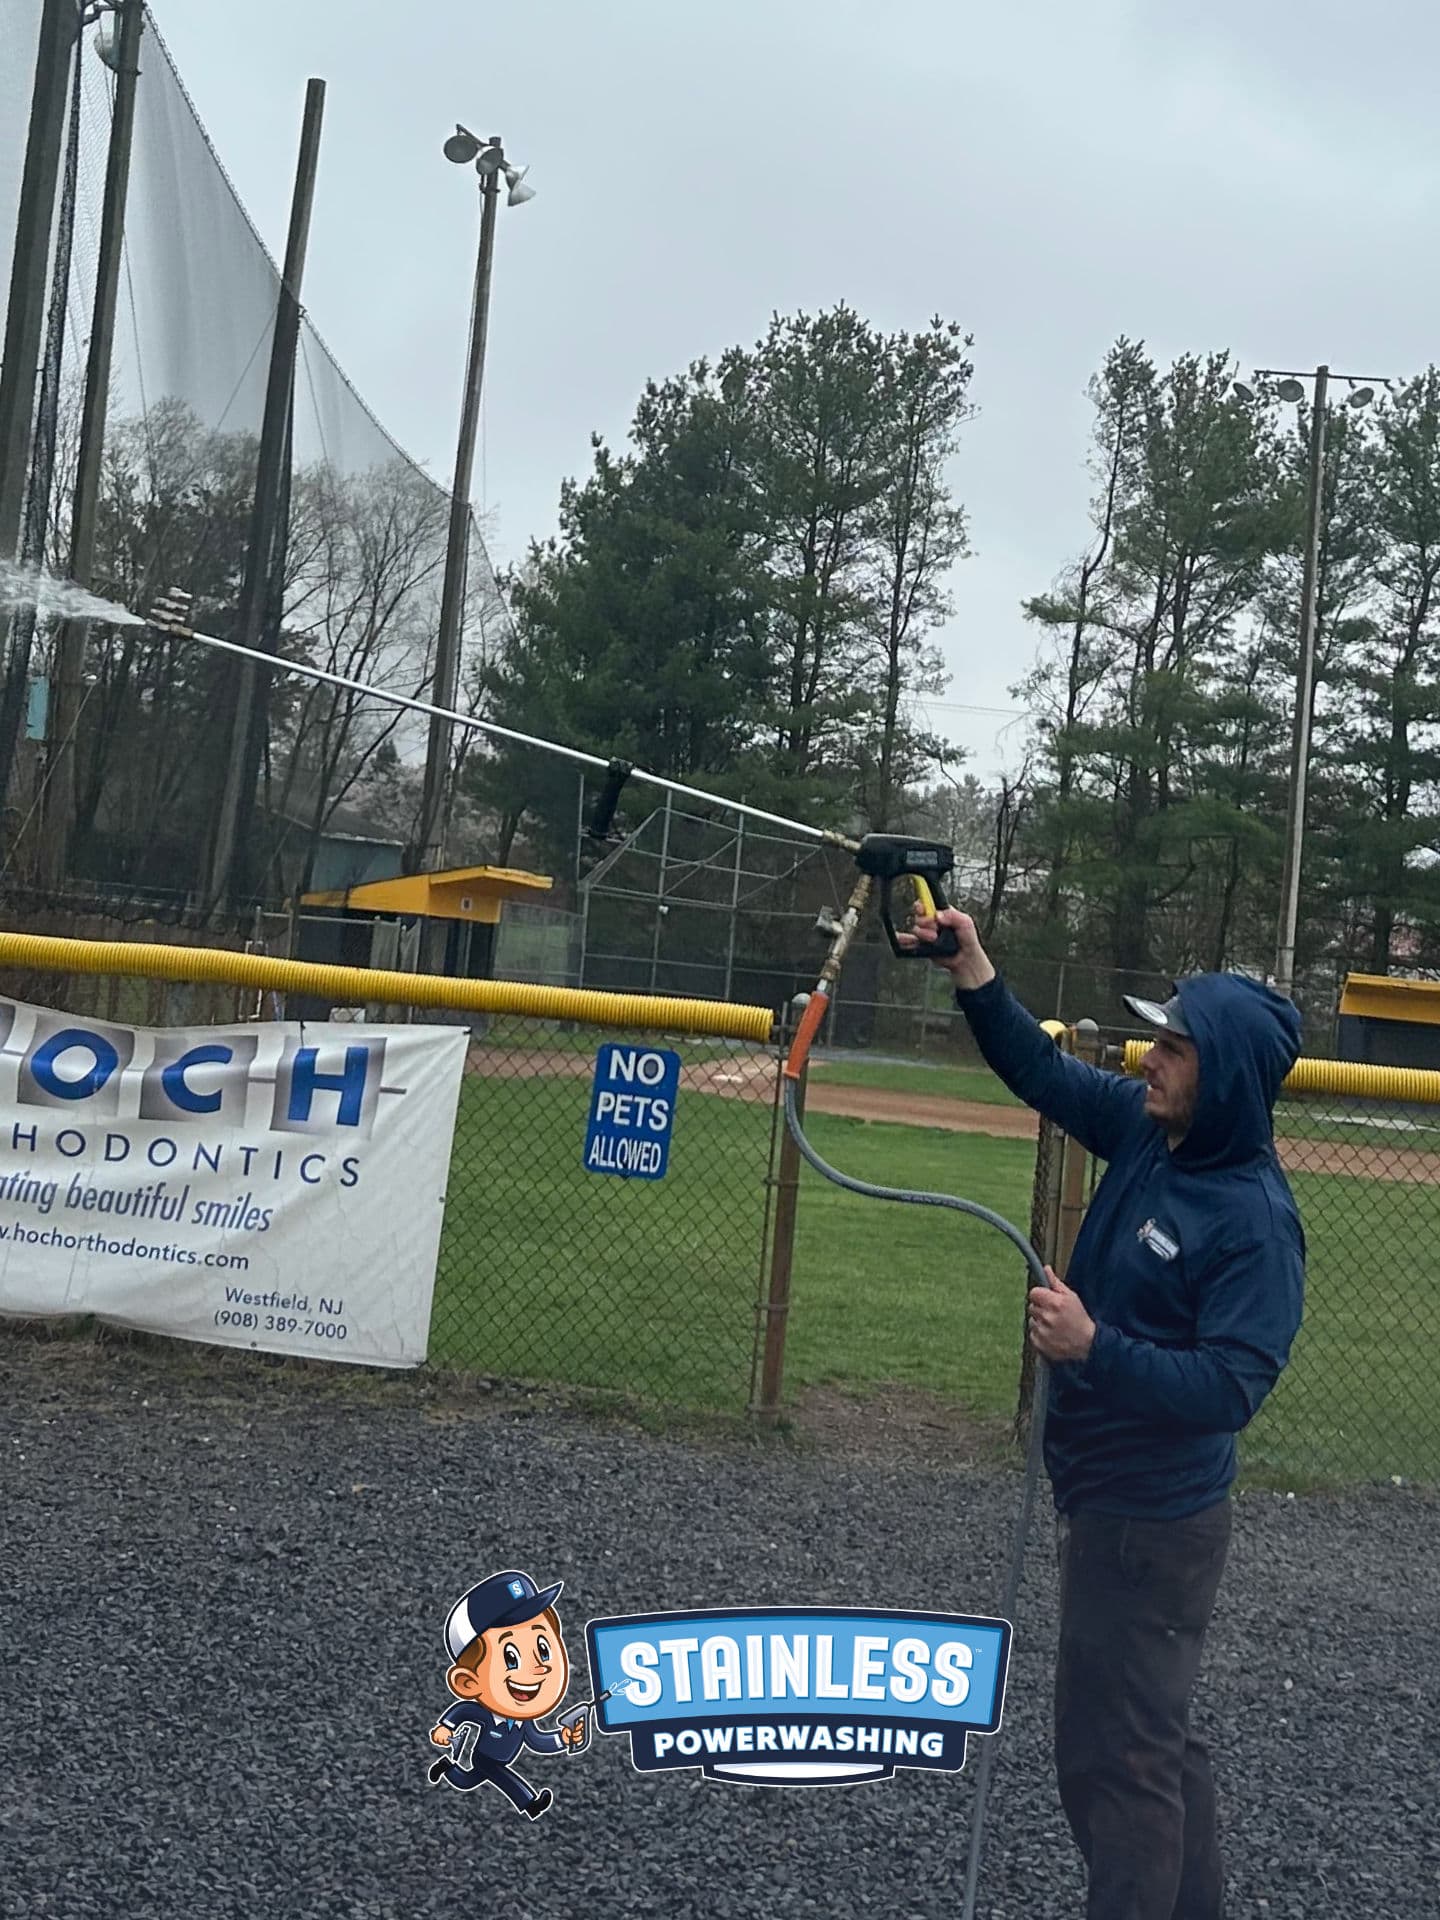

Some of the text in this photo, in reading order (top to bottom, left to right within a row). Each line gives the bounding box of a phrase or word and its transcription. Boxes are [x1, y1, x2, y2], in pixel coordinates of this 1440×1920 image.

[609, 1049, 666, 1085] NO
[596, 1091, 669, 1131] PETS
[12, 1122, 360, 1187] HODONTICS
[588, 1134, 662, 1173] ALLOWED
[64, 1172, 190, 1222] beautiful
[191, 1192, 273, 1232] smiles
[225, 1286, 343, 1315] Westfield, NJ
[214, 1310, 347, 1339] (908) 389-7000
